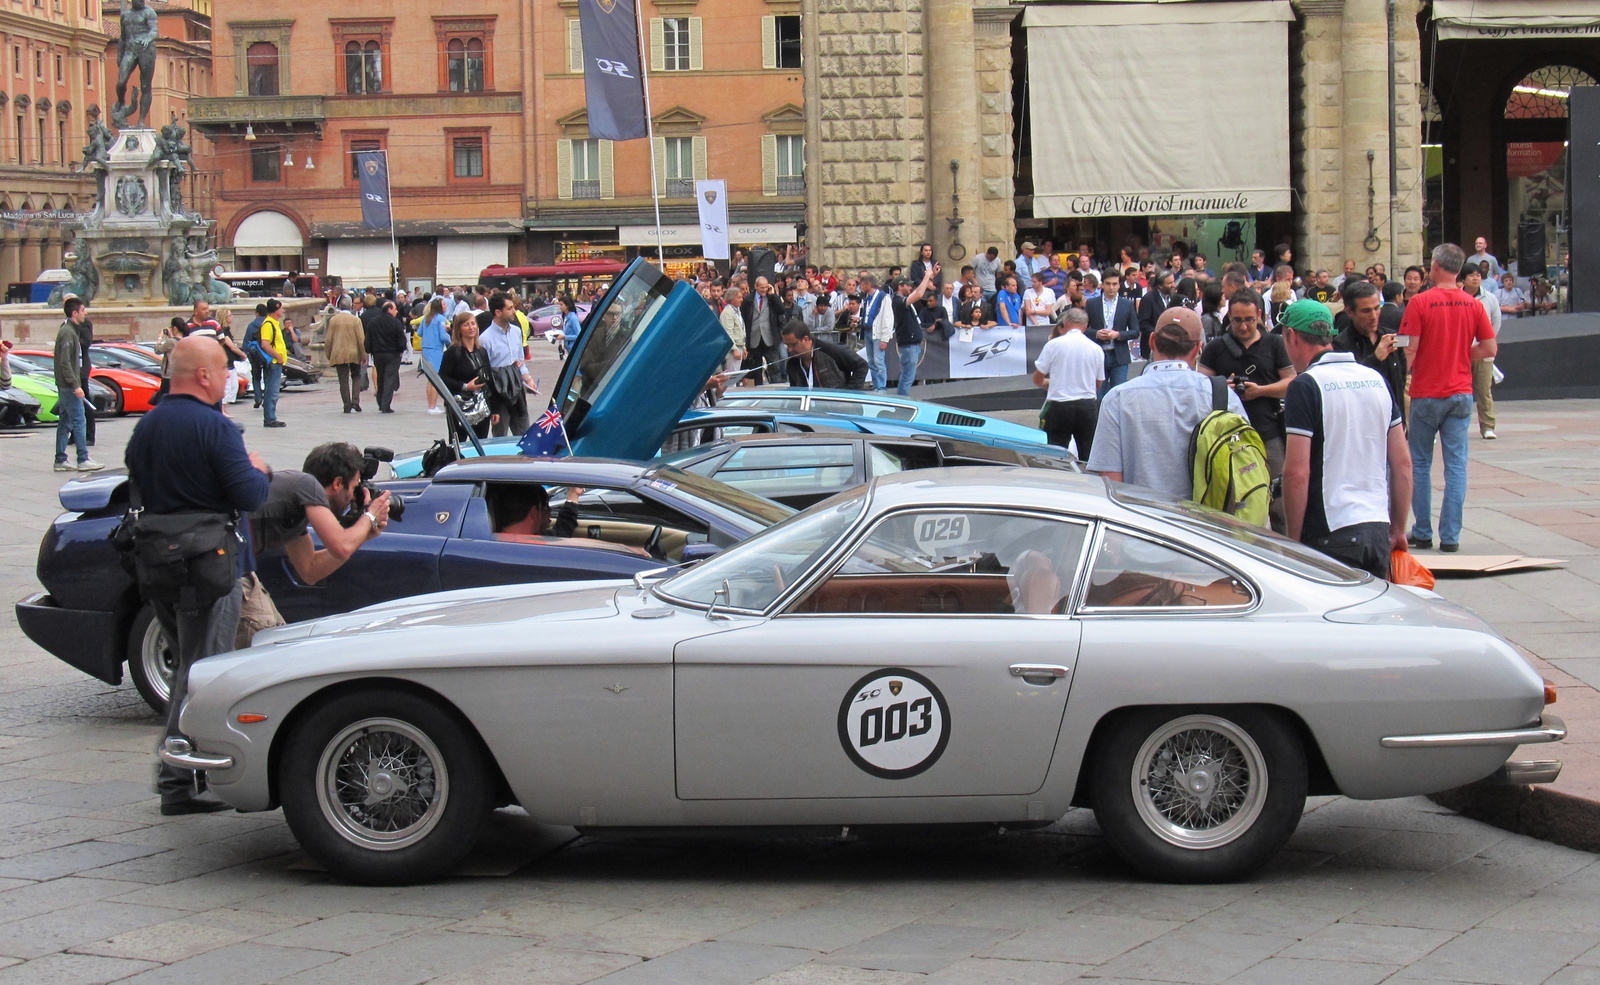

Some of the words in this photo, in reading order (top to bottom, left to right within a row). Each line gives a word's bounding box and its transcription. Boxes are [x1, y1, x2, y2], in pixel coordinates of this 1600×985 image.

[1168, 192, 1248, 212] Emanuele
[43, 211, 57, 219] San
[59, 211, 75, 219] Luca
[231, 279, 264, 287] www.tper.it
[1429, 300, 1474, 309] MAMMUT
[1323, 380, 1384, 392] COLLAUDATORE
[919, 516, 966, 542] 029
[859, 696, 932, 748] 003
